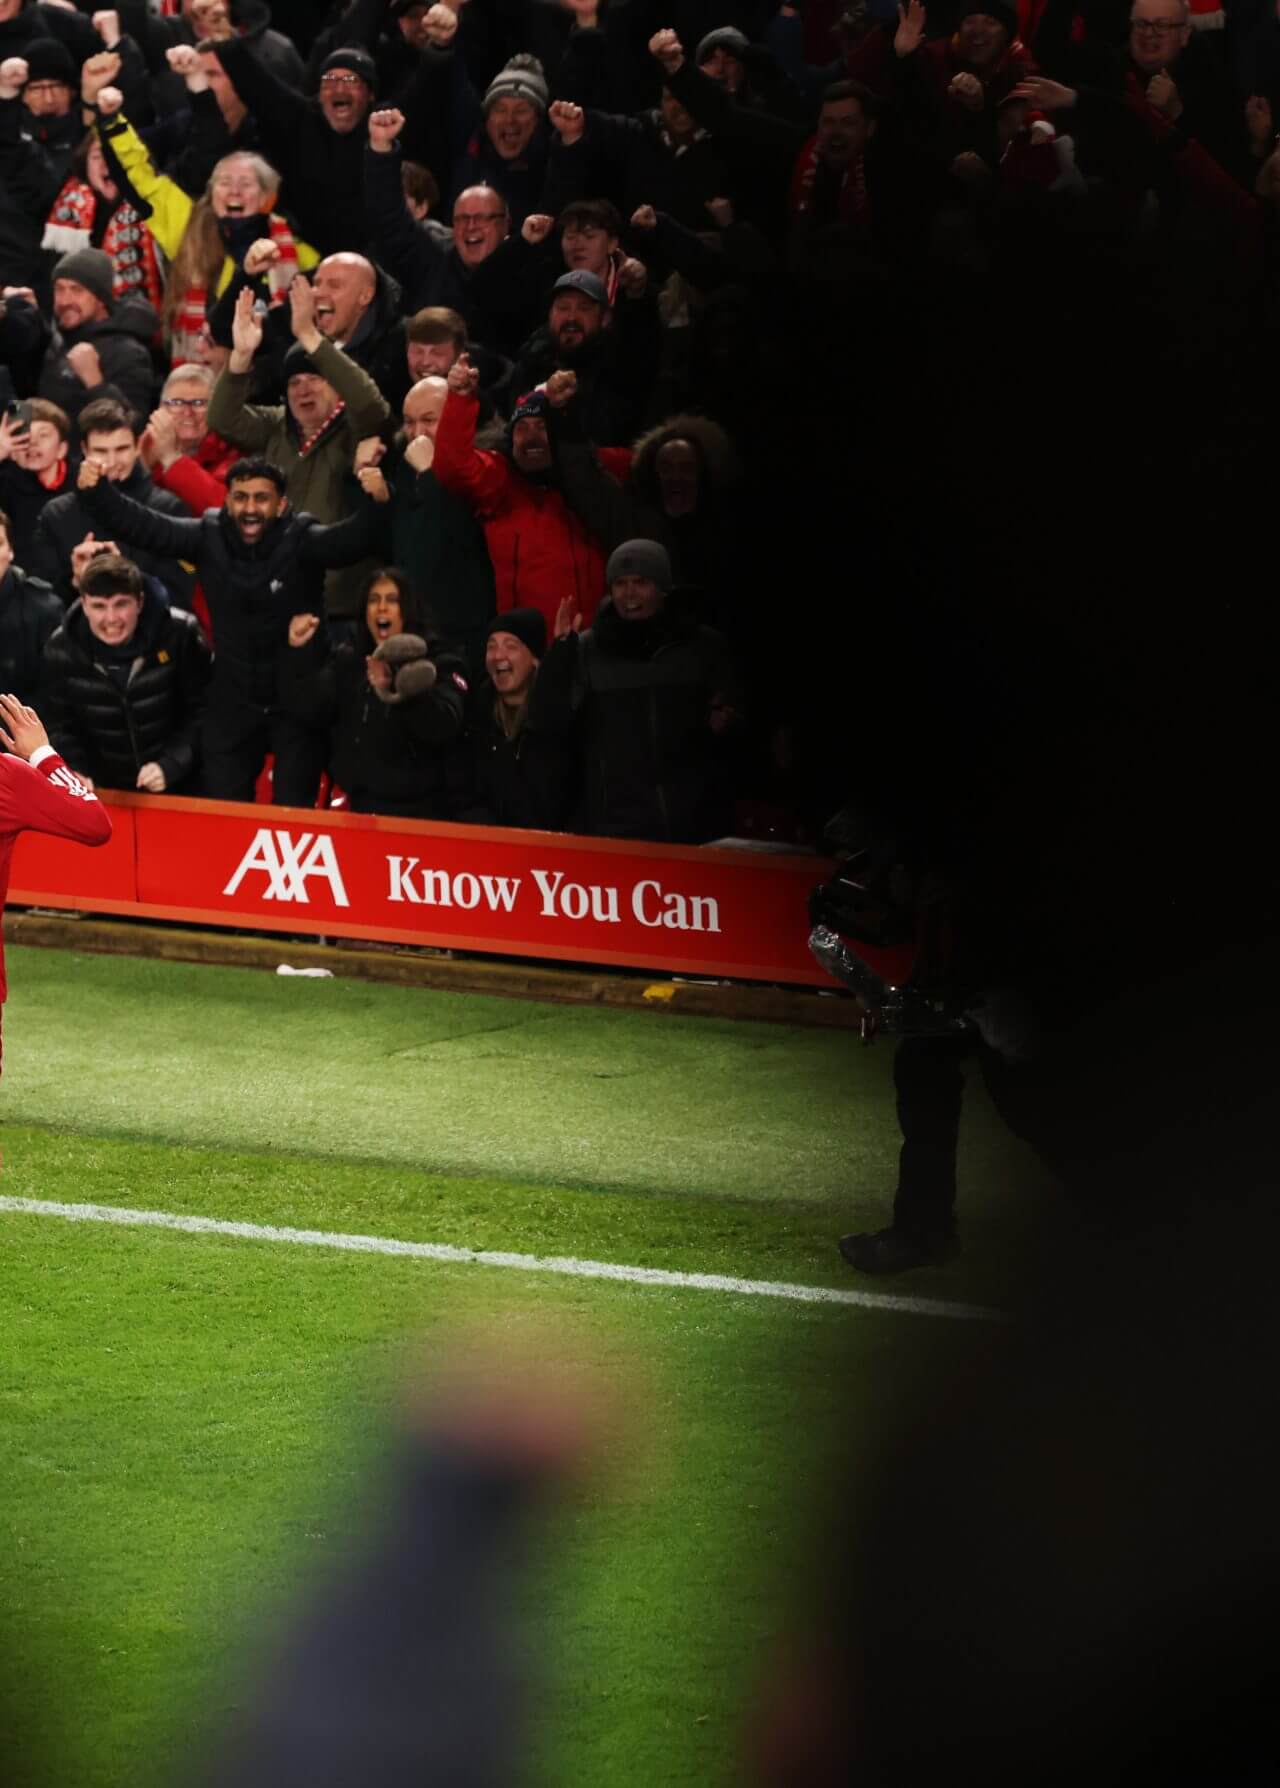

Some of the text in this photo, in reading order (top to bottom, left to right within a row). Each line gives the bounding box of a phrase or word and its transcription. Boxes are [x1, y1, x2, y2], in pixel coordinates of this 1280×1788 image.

[223, 828, 349, 907] AXA
[386, 855, 721, 932] Know You Can
